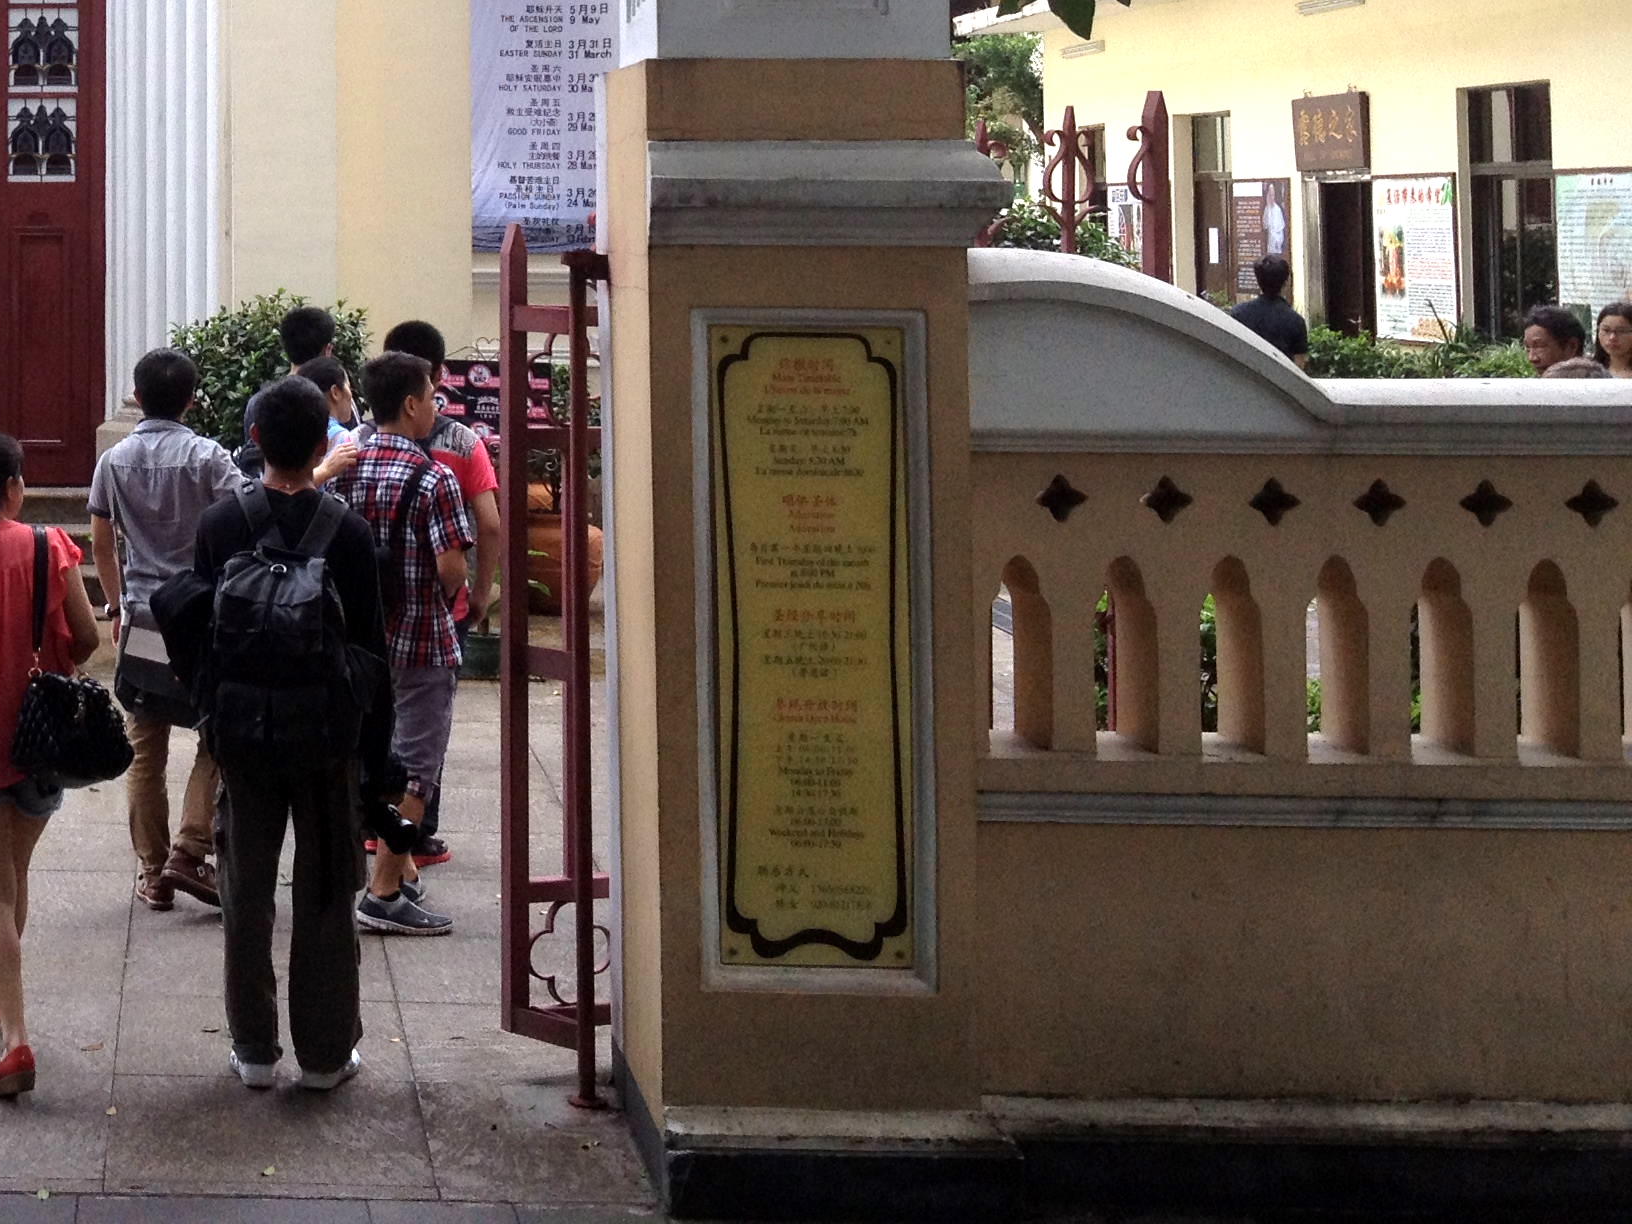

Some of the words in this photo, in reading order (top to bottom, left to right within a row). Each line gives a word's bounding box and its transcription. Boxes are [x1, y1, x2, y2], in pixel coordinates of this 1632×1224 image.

[501, 15, 514, 23] THE
[519, 15, 563, 23] ASCENSION
[570, 16, 576, 24] 9
[582, 16, 600, 25] May
[568, 51, 578, 59] 31
[584, 50, 612, 59] March
[568, 85, 578, 93] 30
[568, 123, 578, 131] 29
[567, 162, 577, 170] 28
[530, 202, 560, 210] Sunday)
[567, 199, 578, 207] 24
